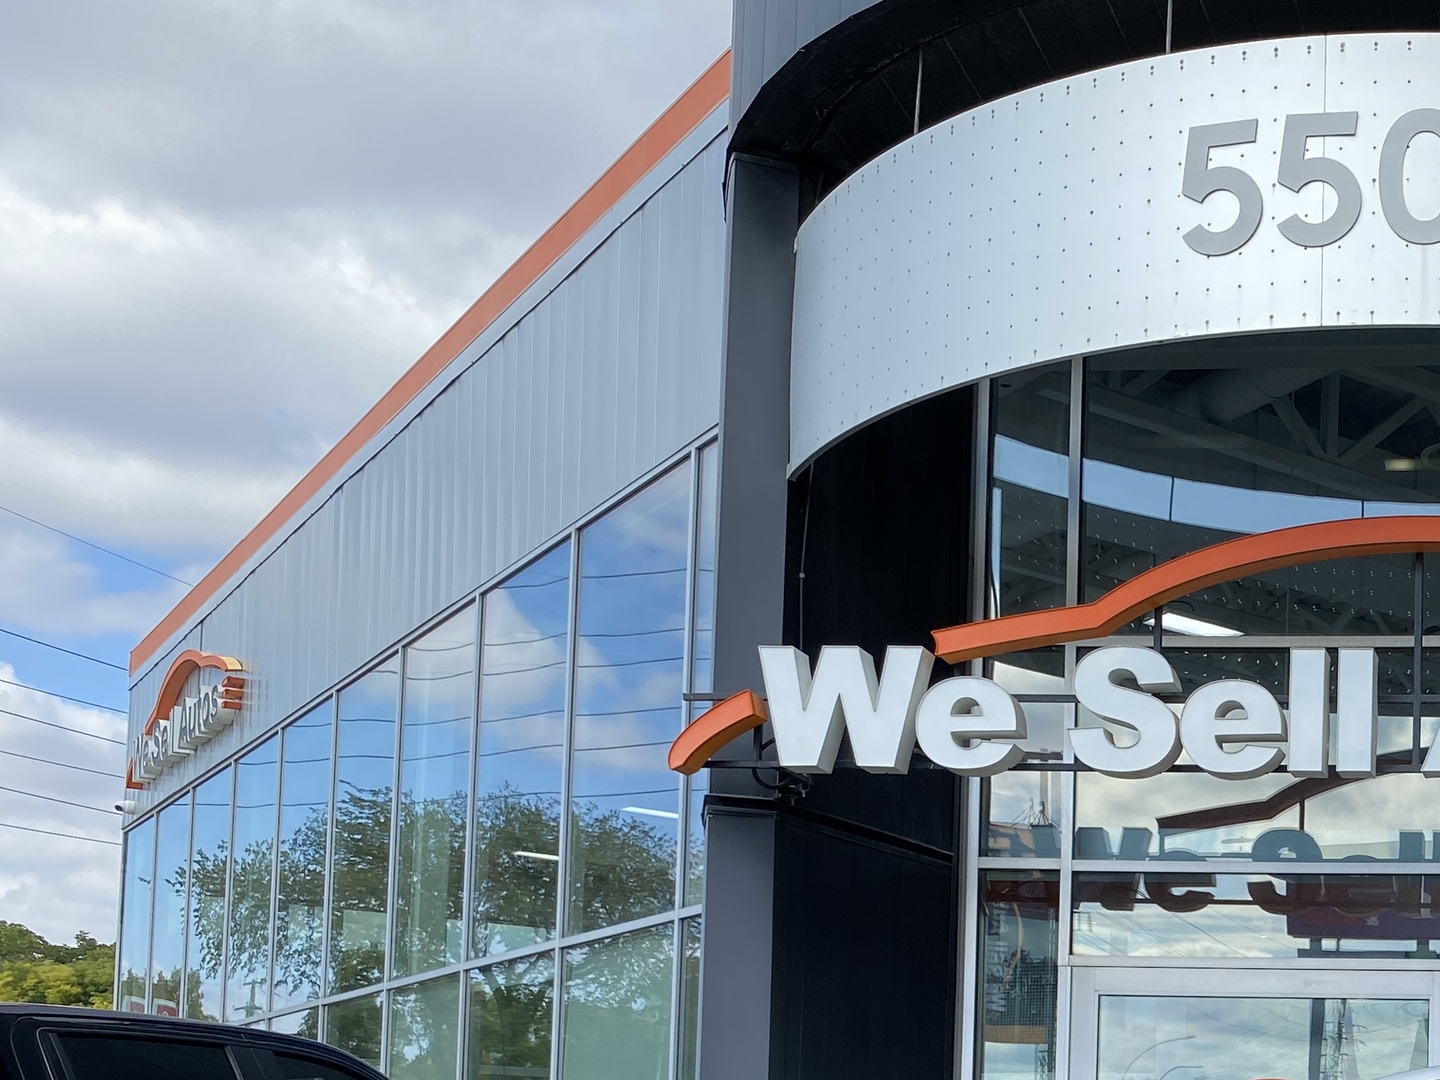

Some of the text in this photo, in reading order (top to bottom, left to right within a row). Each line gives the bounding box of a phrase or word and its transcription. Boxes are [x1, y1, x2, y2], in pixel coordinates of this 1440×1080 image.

[178, 684, 224, 750] Autos
[758, 644, 1027, 777] We
[1067, 644, 1379, 780] Sell
